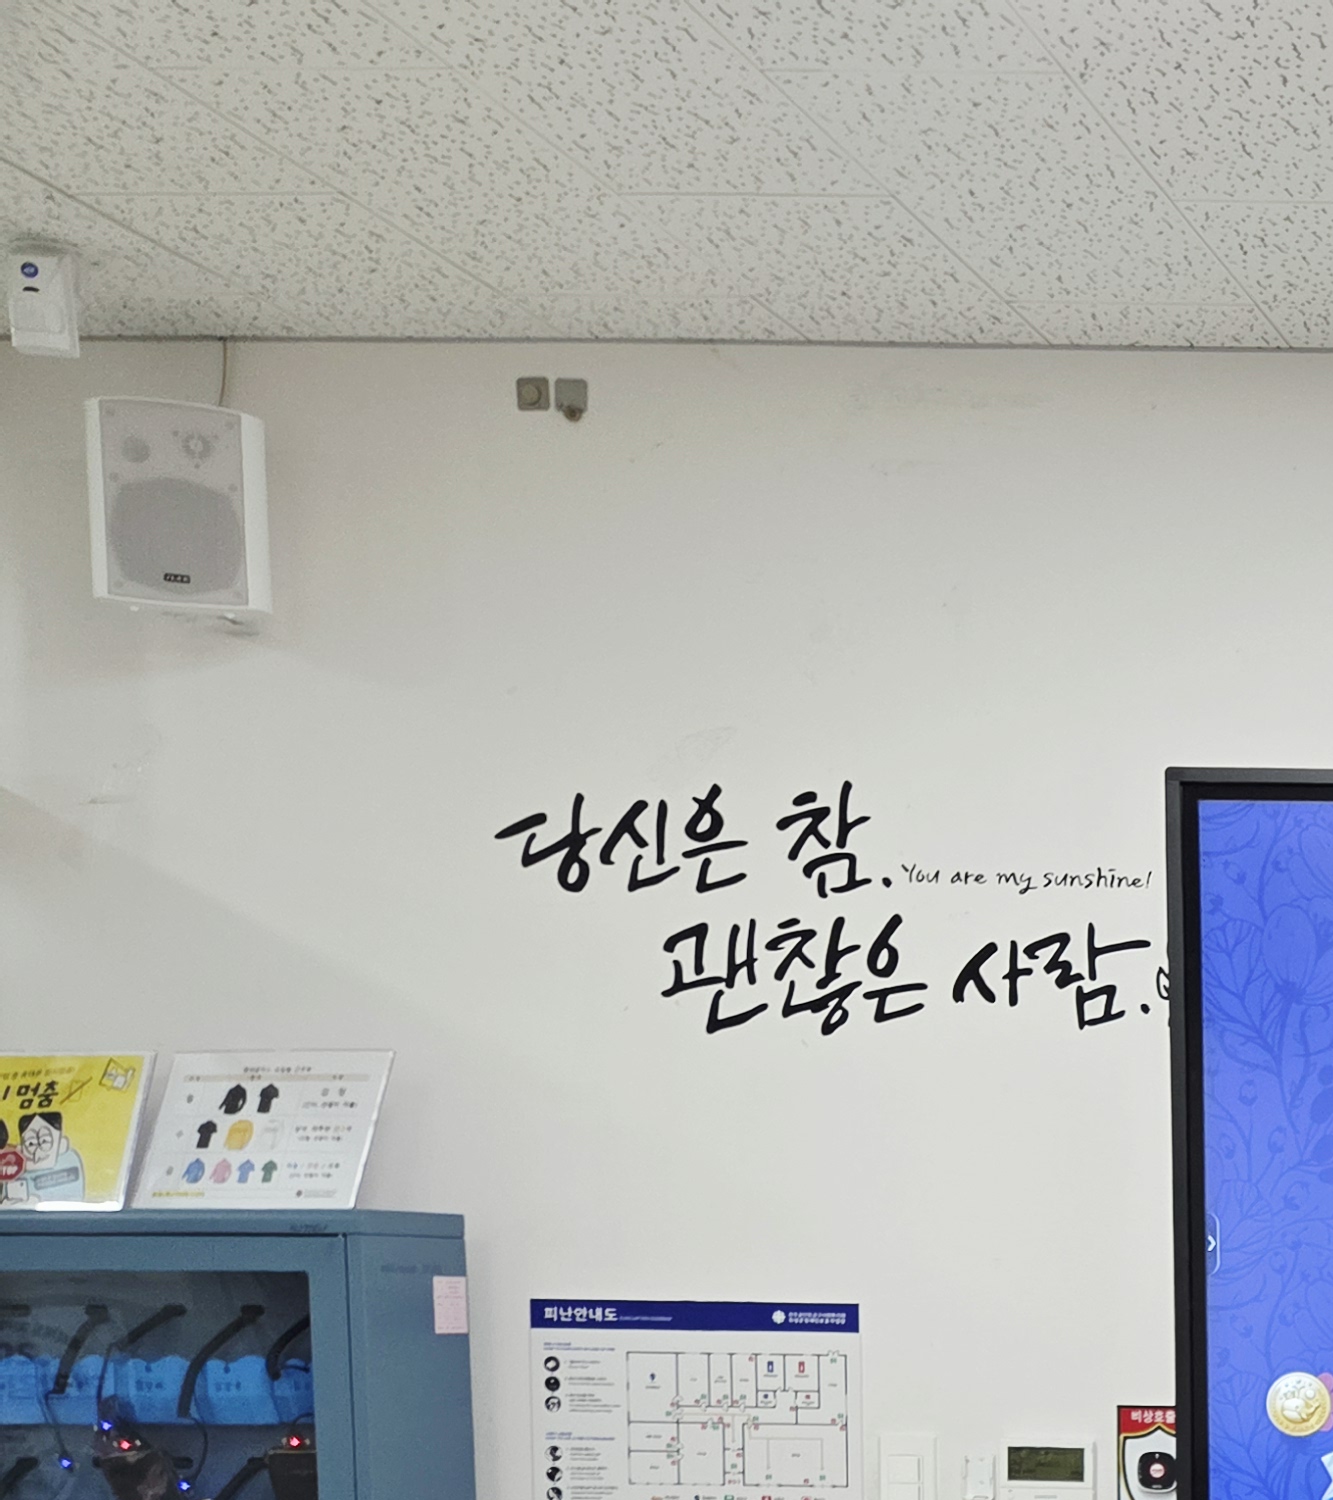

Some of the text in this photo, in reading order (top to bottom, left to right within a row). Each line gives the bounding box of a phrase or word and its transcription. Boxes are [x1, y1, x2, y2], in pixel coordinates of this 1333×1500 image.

[494, 780, 893, 898] 당신은 참.
[901, 863, 1153, 895] You are my sunshine!
[661, 914, 1152, 1035] 괜찮은 사람.
[544, 1305, 619, 1323] 피난안내도
